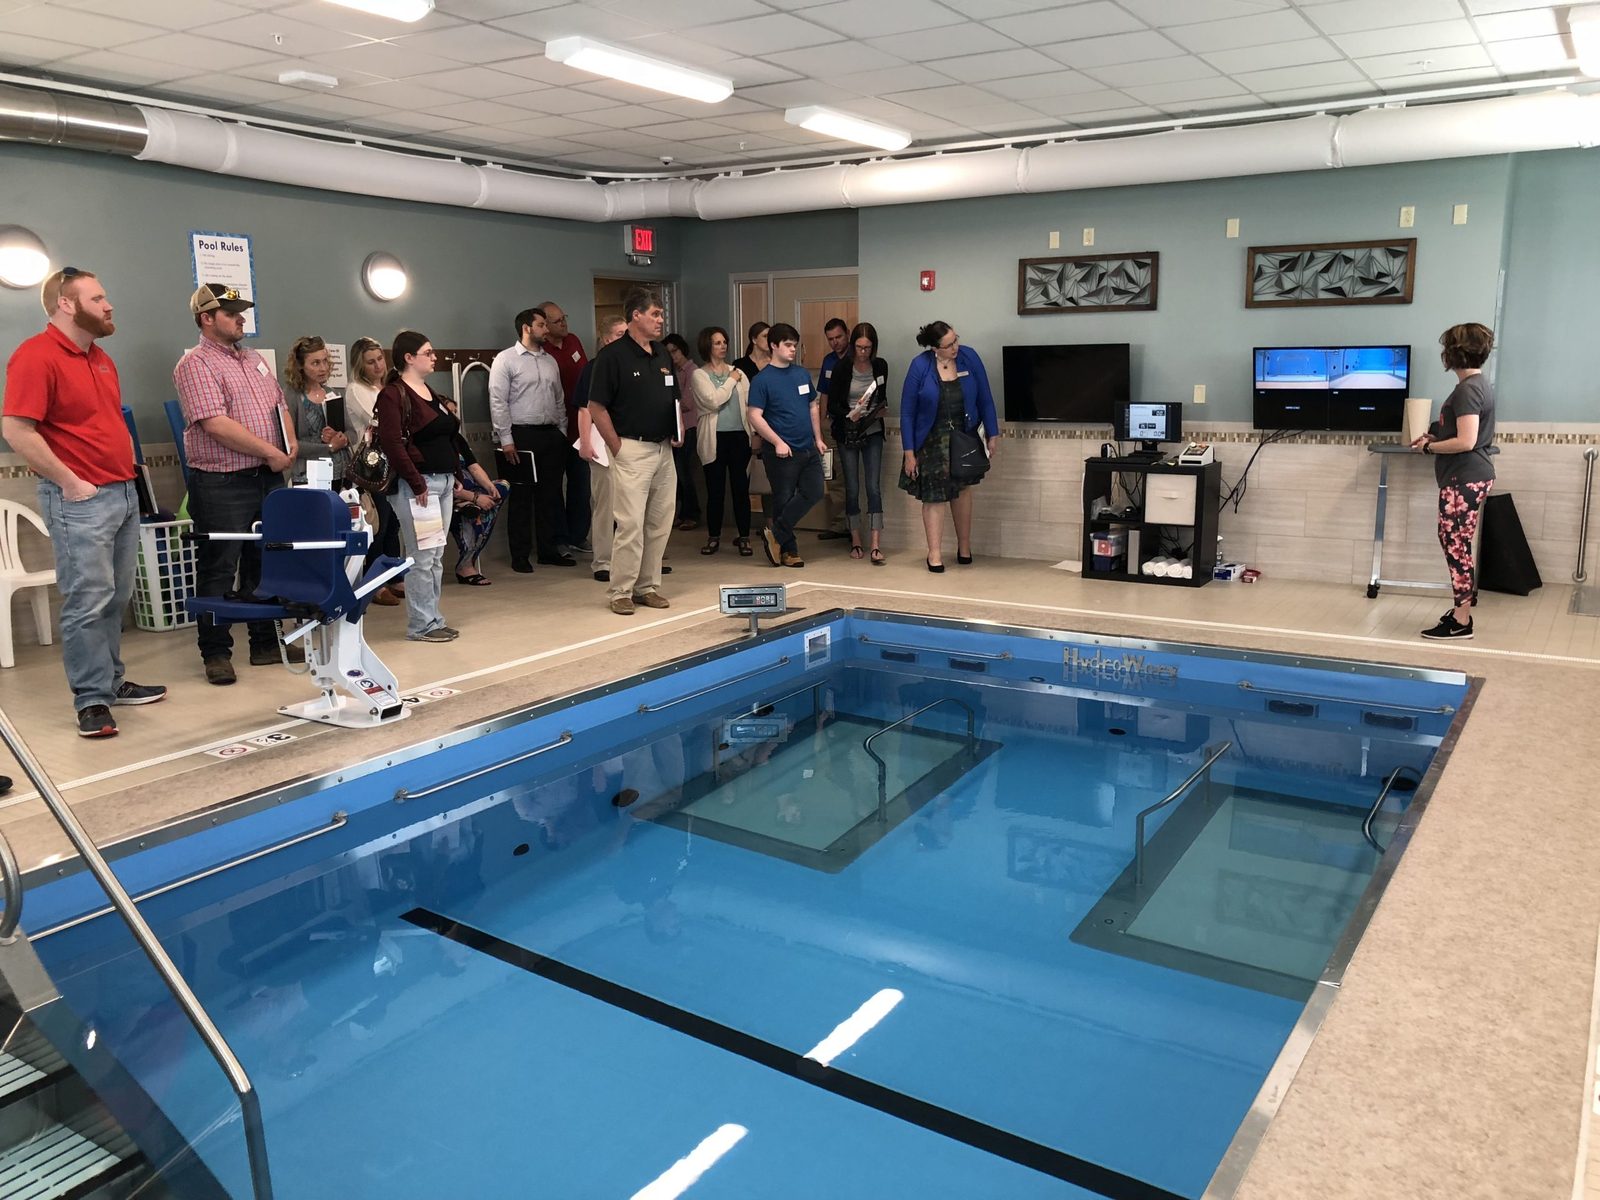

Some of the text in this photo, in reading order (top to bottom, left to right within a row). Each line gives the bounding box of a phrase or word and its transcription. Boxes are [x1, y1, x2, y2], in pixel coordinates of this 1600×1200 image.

[199, 240, 244, 252] Pool Rules
[635, 229, 653, 251] EXIT
